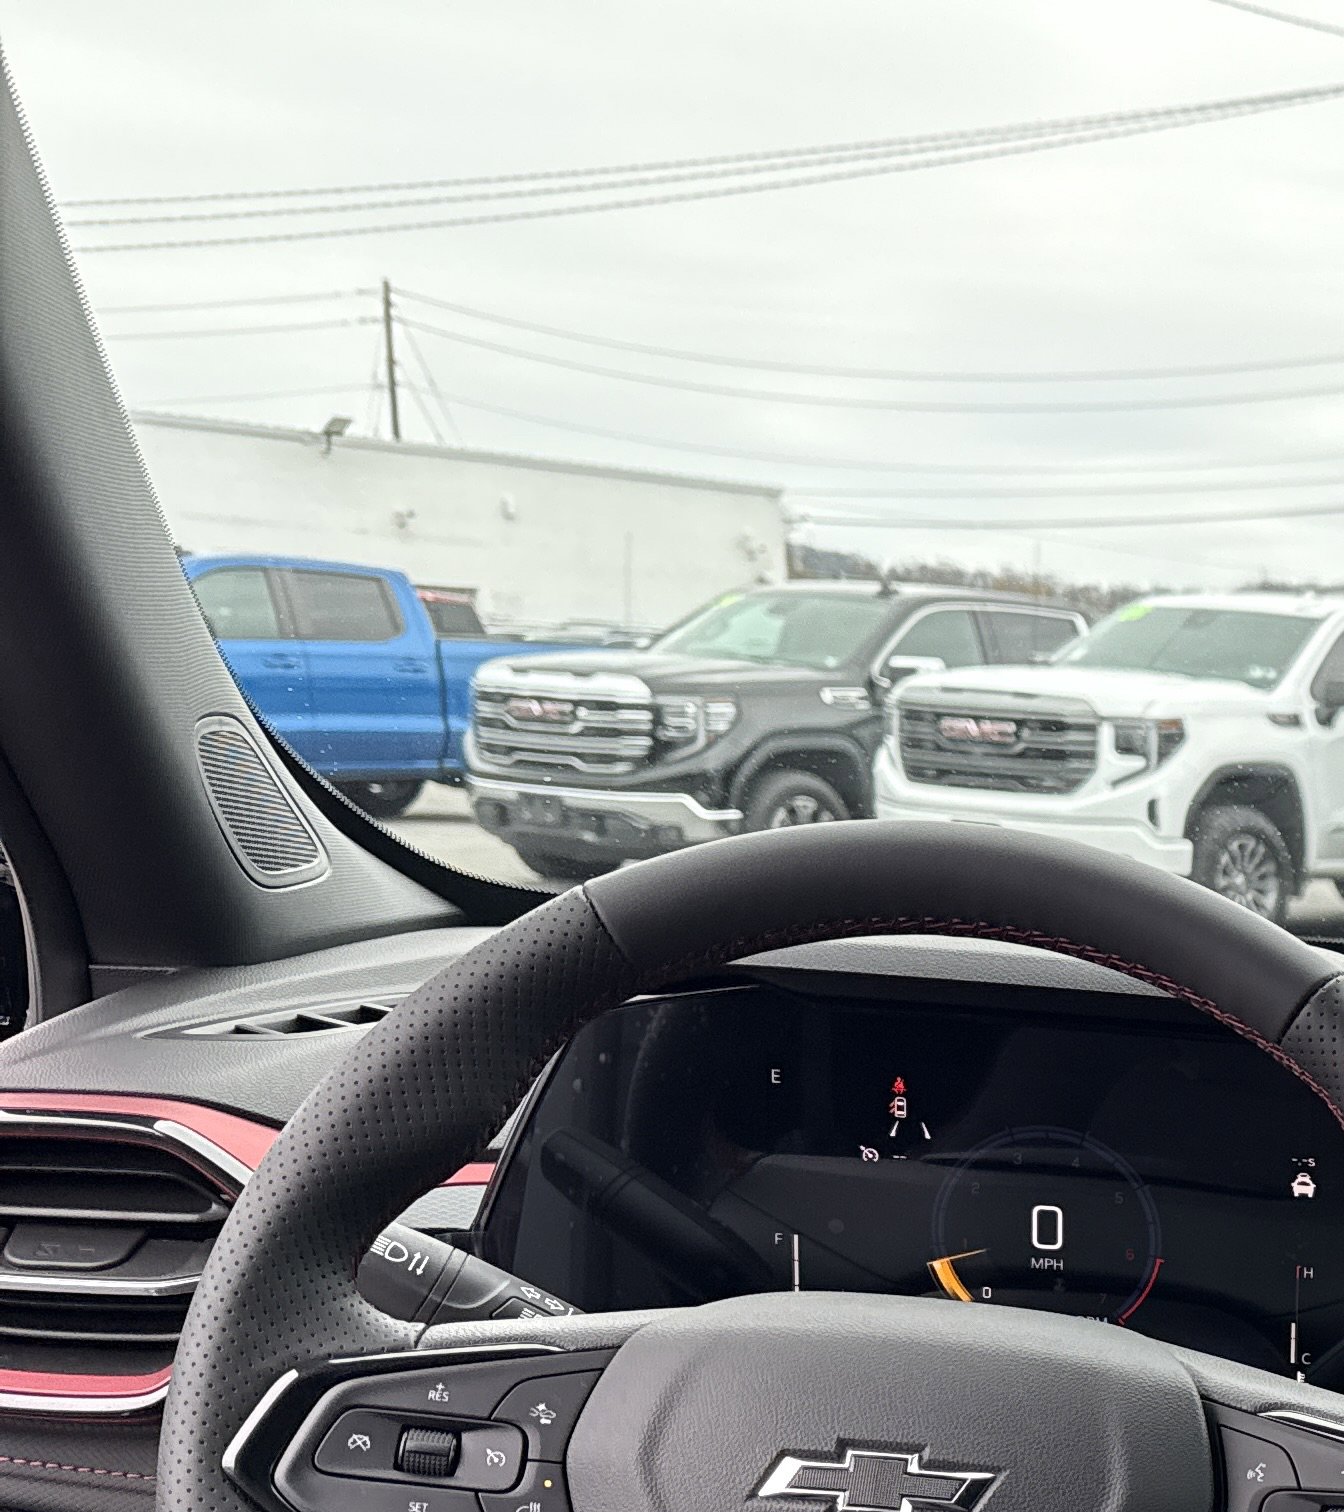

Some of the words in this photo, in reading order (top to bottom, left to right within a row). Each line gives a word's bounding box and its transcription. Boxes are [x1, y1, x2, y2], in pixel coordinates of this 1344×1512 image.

[771, 1068, 782, 1084] E
[1031, 1205, 1063, 1250] 0
[774, 1232, 783, 1245] F
[1030, 1257, 1064, 1271] MPH
[1303, 1266, 1314, 1279] H
[1301, 1352, 1312, 1365] C
